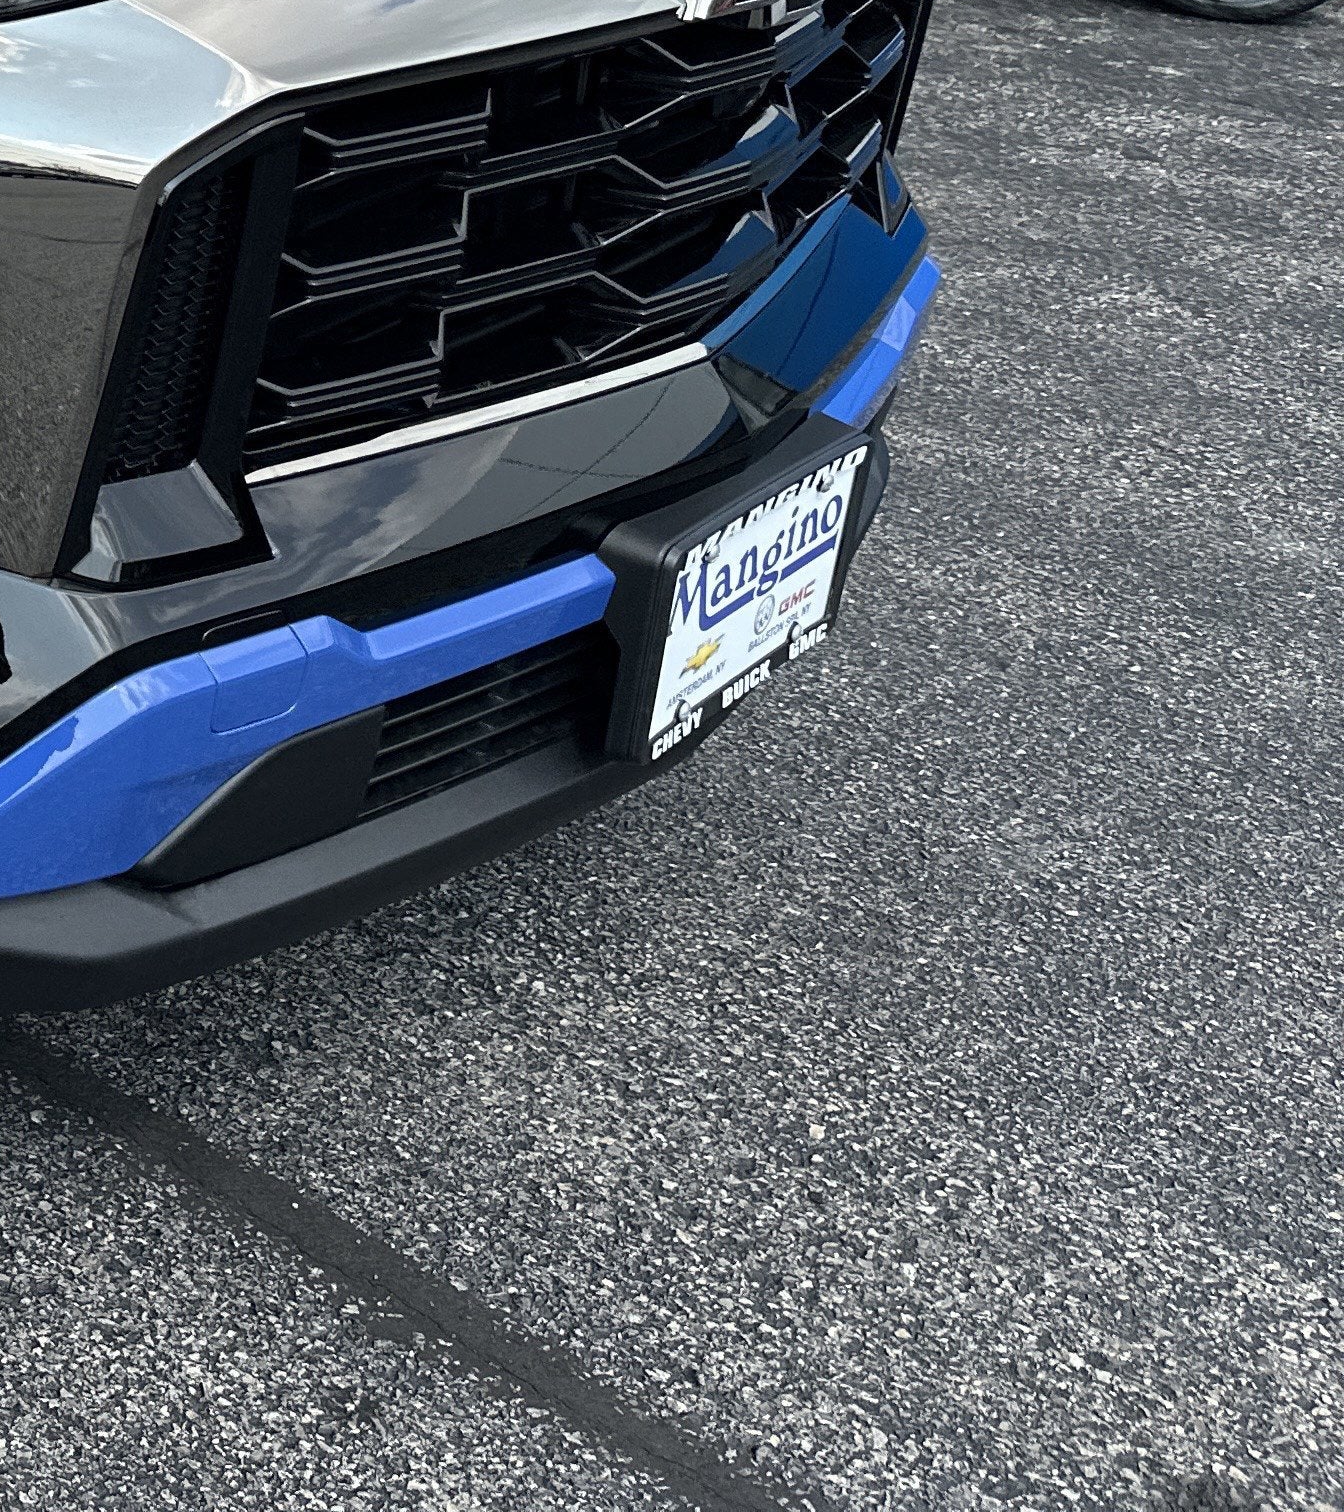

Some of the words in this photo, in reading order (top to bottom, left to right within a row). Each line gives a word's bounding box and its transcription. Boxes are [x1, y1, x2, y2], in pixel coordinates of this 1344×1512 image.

[670, 494, 844, 632] Mangino
[684, 445, 868, 569] MANGINO
[778, 579, 816, 616] GMC
[651, 707, 703, 761] CHEVY
[722, 658, 771, 709] BUICK
[788, 623, 828, 660] GMC
